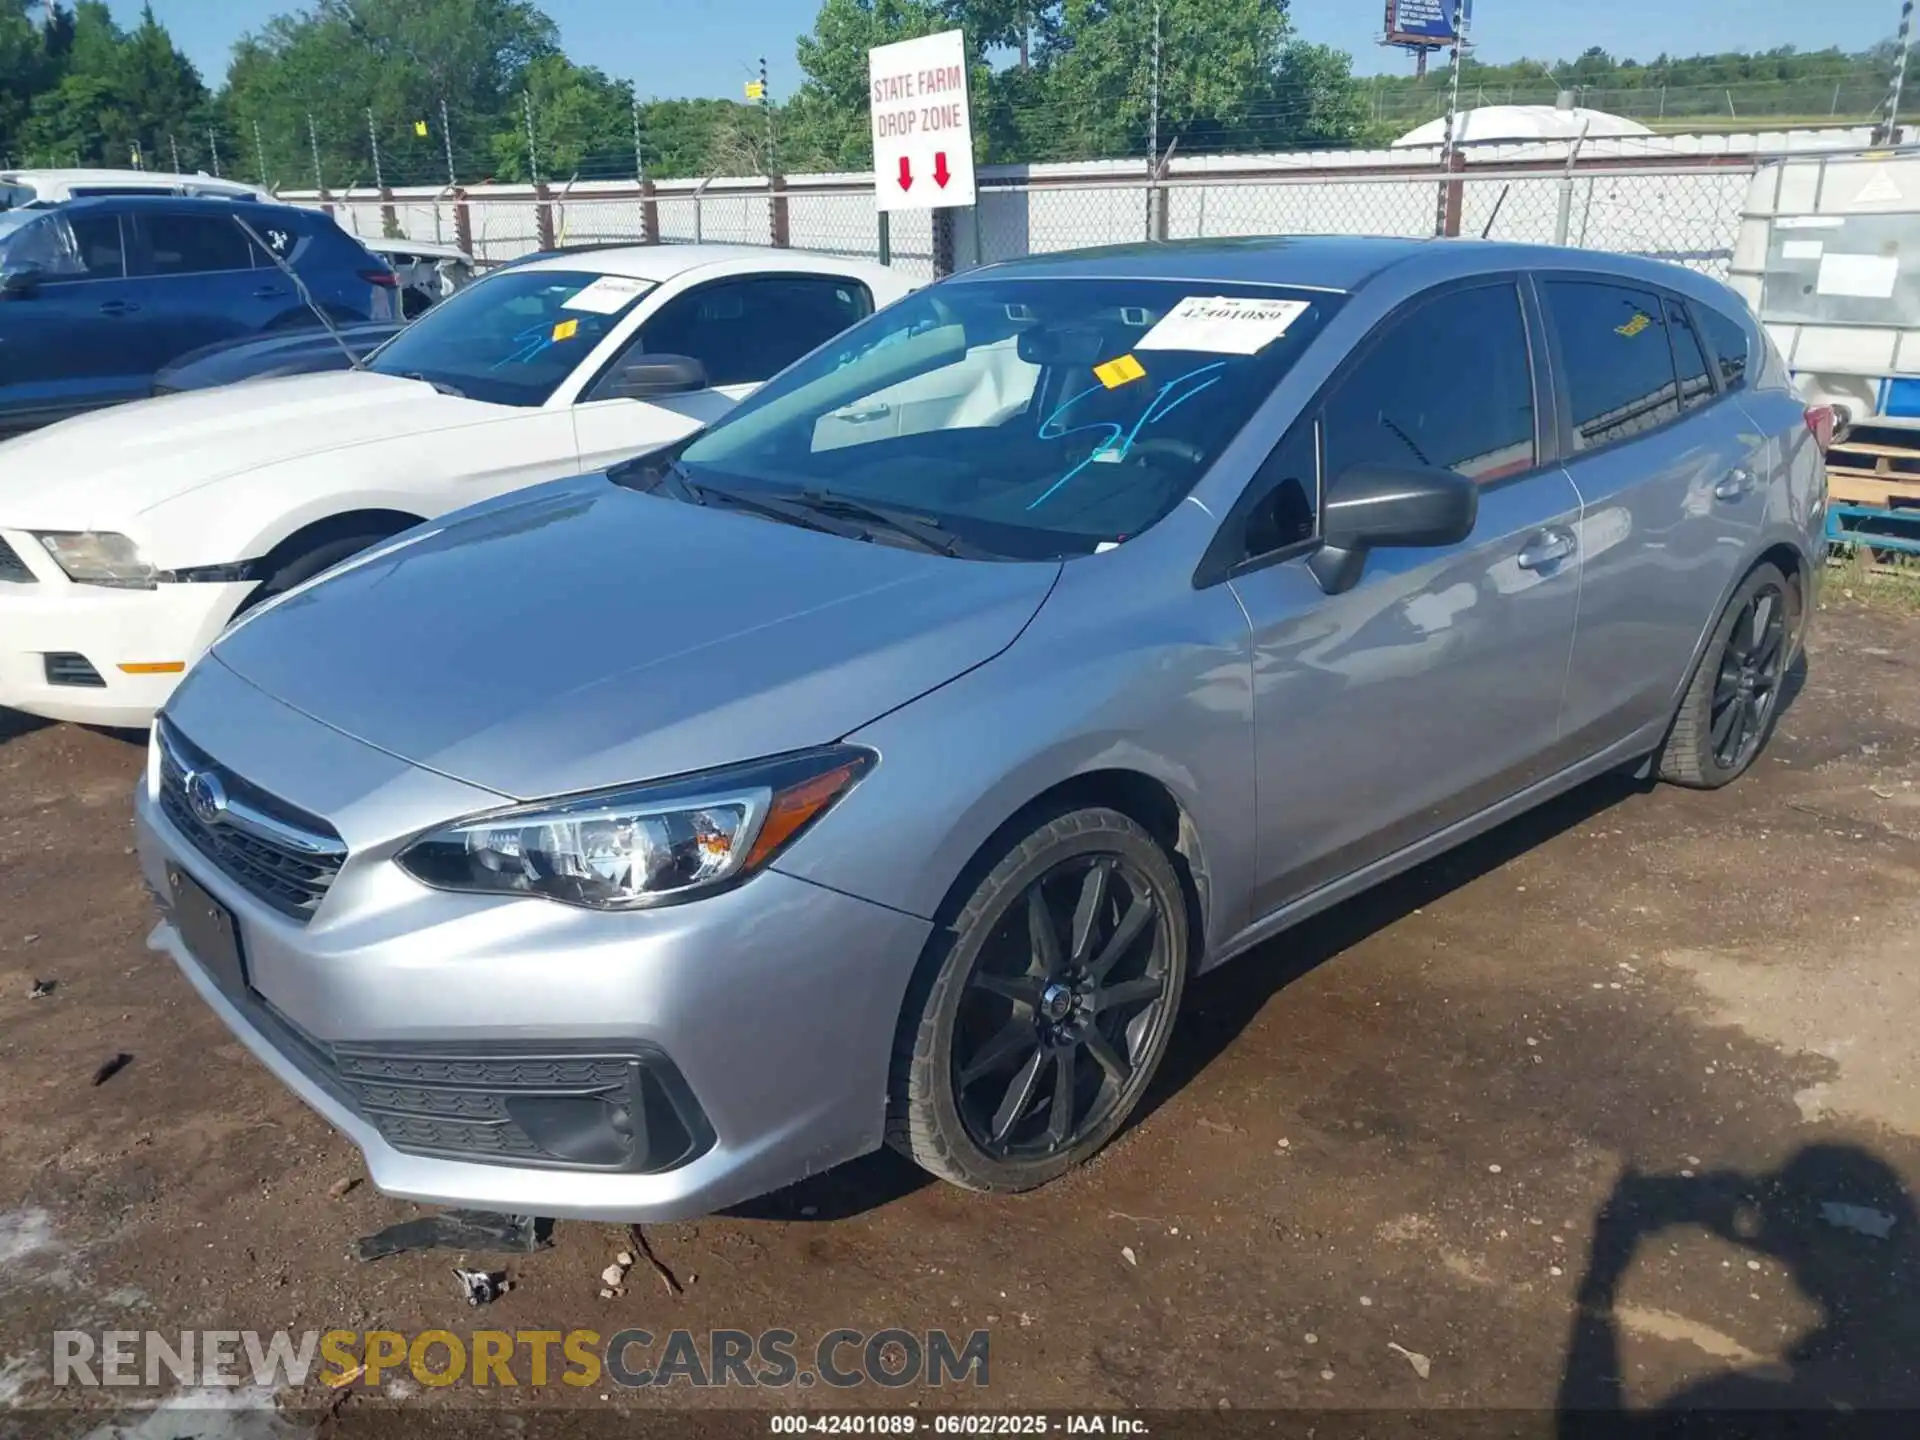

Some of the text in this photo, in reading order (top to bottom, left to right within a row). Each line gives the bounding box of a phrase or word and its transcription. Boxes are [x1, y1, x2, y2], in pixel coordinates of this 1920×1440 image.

[874, 65, 961, 103] STATE FARM
[879, 103, 962, 137] DROP ZONE
